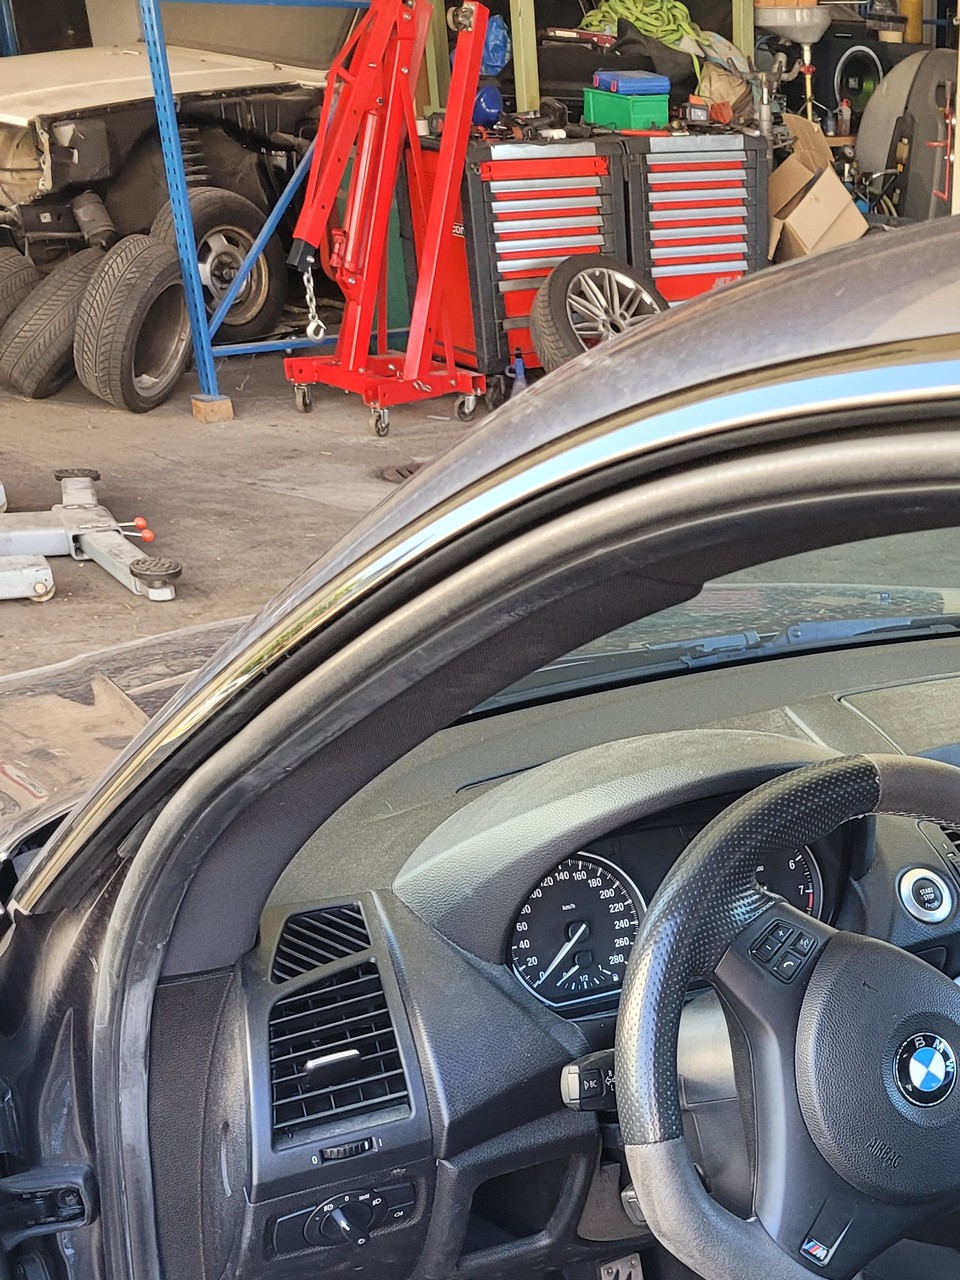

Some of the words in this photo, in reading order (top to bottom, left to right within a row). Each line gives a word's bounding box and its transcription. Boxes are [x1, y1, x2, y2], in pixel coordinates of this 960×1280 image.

[788, 859, 796, 870] 6
[554, 871, 570, 882] 140
[572, 870, 587, 881] 160
[587, 877, 602, 888] 180
[529, 888, 543, 899] 00
[599, 888, 615, 899] 200
[798, 885, 804, 896] 7
[608, 902, 624, 914] 220
[516, 921, 528, 932] 60
[614, 918, 630, 930] 240
[519, 939, 530, 950] 40
[614, 936, 630, 948] 260
[526, 956, 538, 967] 20
[608, 953, 624, 965] 280
[914, 1036, 954, 1073] BMW
[864, 1136, 903, 1168] AIRBAG
